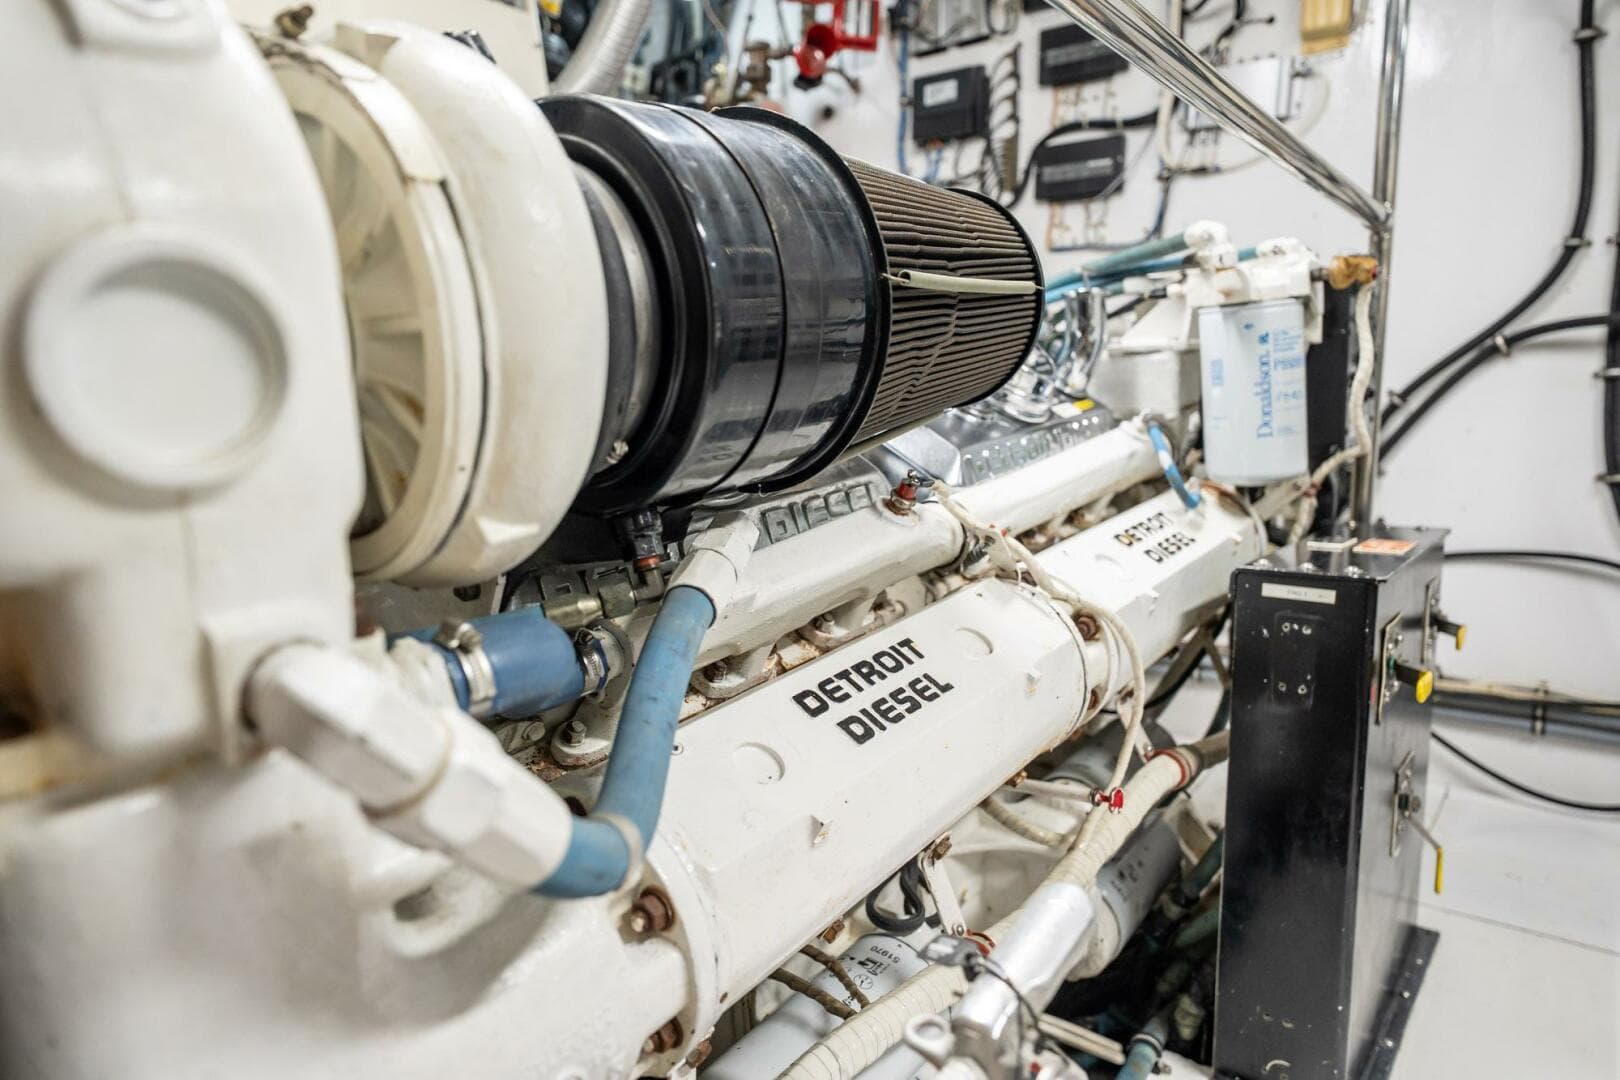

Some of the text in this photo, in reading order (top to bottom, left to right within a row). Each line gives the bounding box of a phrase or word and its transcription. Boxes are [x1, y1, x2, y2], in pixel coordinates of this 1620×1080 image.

[1114, 512, 1174, 546] DETROIT
[1143, 532, 1196, 562] DIESEL
[792, 637, 925, 718] DETROIT
[836, 673, 954, 745] DIESEL
[869, 944, 901, 964] 51970
